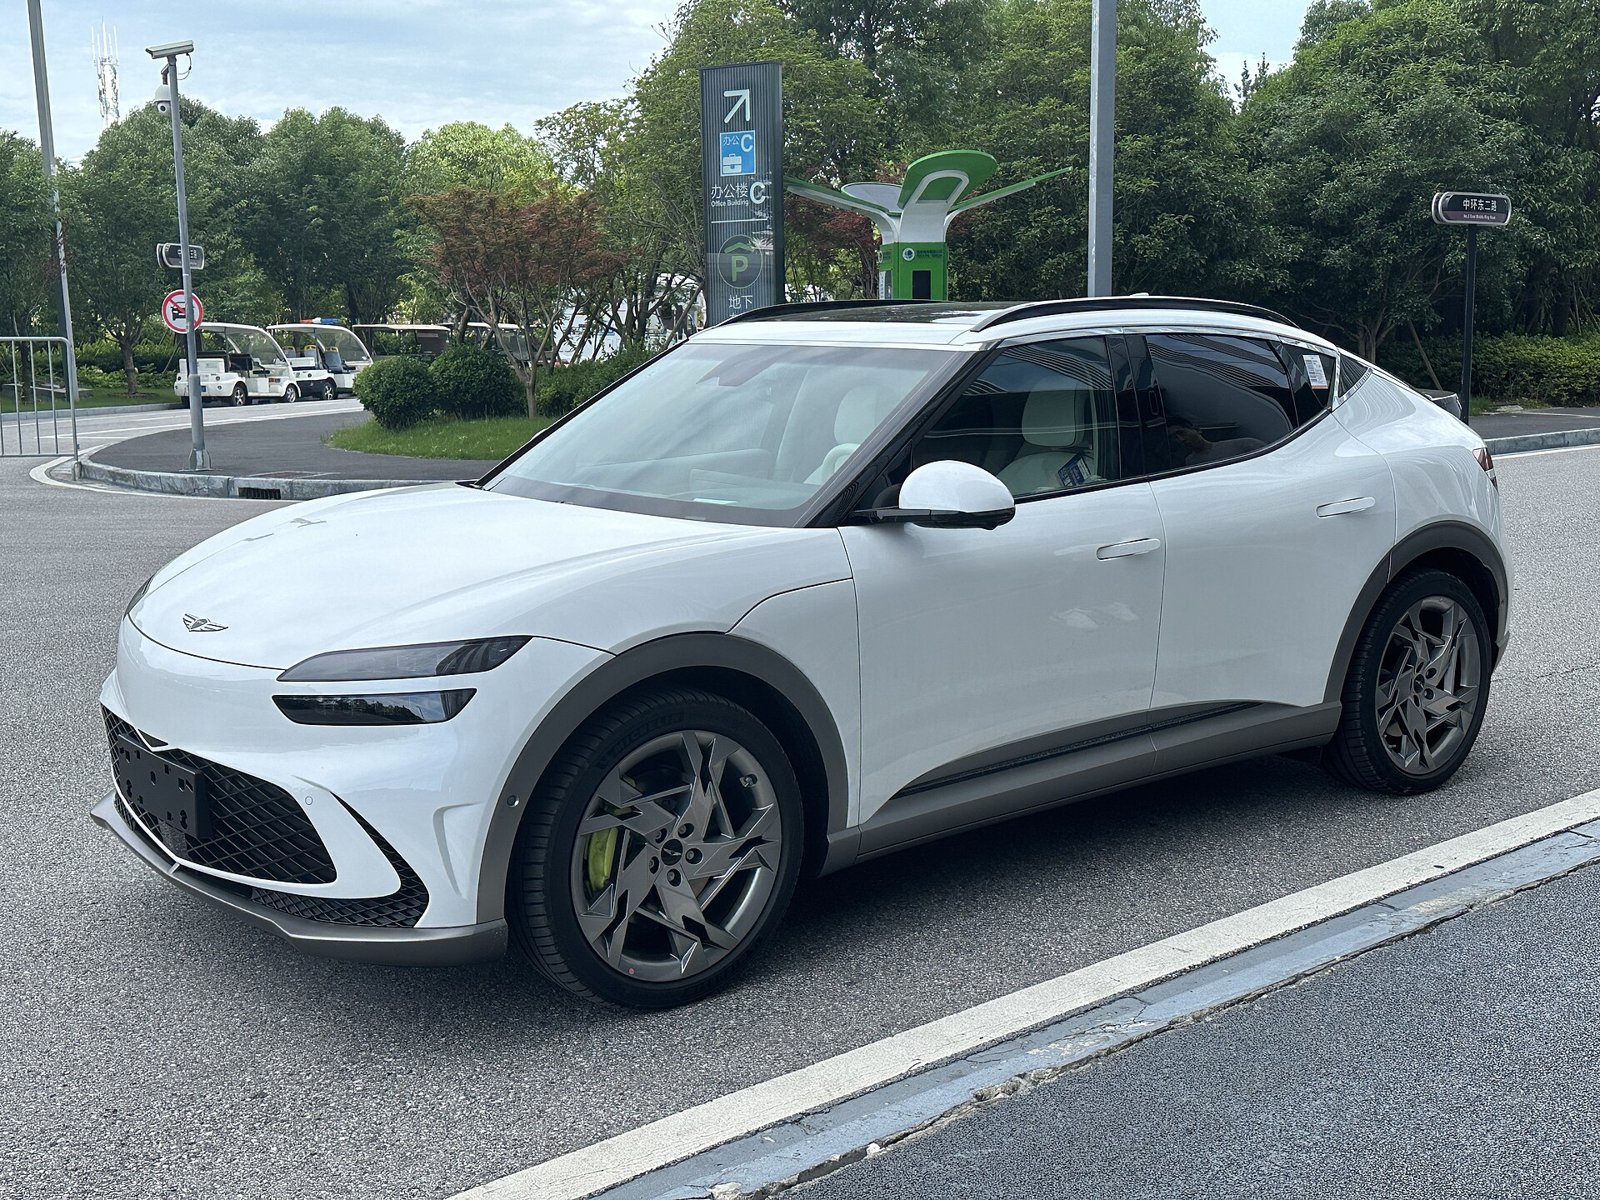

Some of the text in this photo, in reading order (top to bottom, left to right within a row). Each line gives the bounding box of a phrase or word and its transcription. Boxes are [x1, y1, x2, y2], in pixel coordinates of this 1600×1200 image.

[723, 134, 753, 152] 办公 C
[711, 182, 766, 204] 办公楼 C
[1463, 198, 1497, 211] 中环东二路
[731, 255, 749, 282] P
[729, 295, 753, 309] 地下
